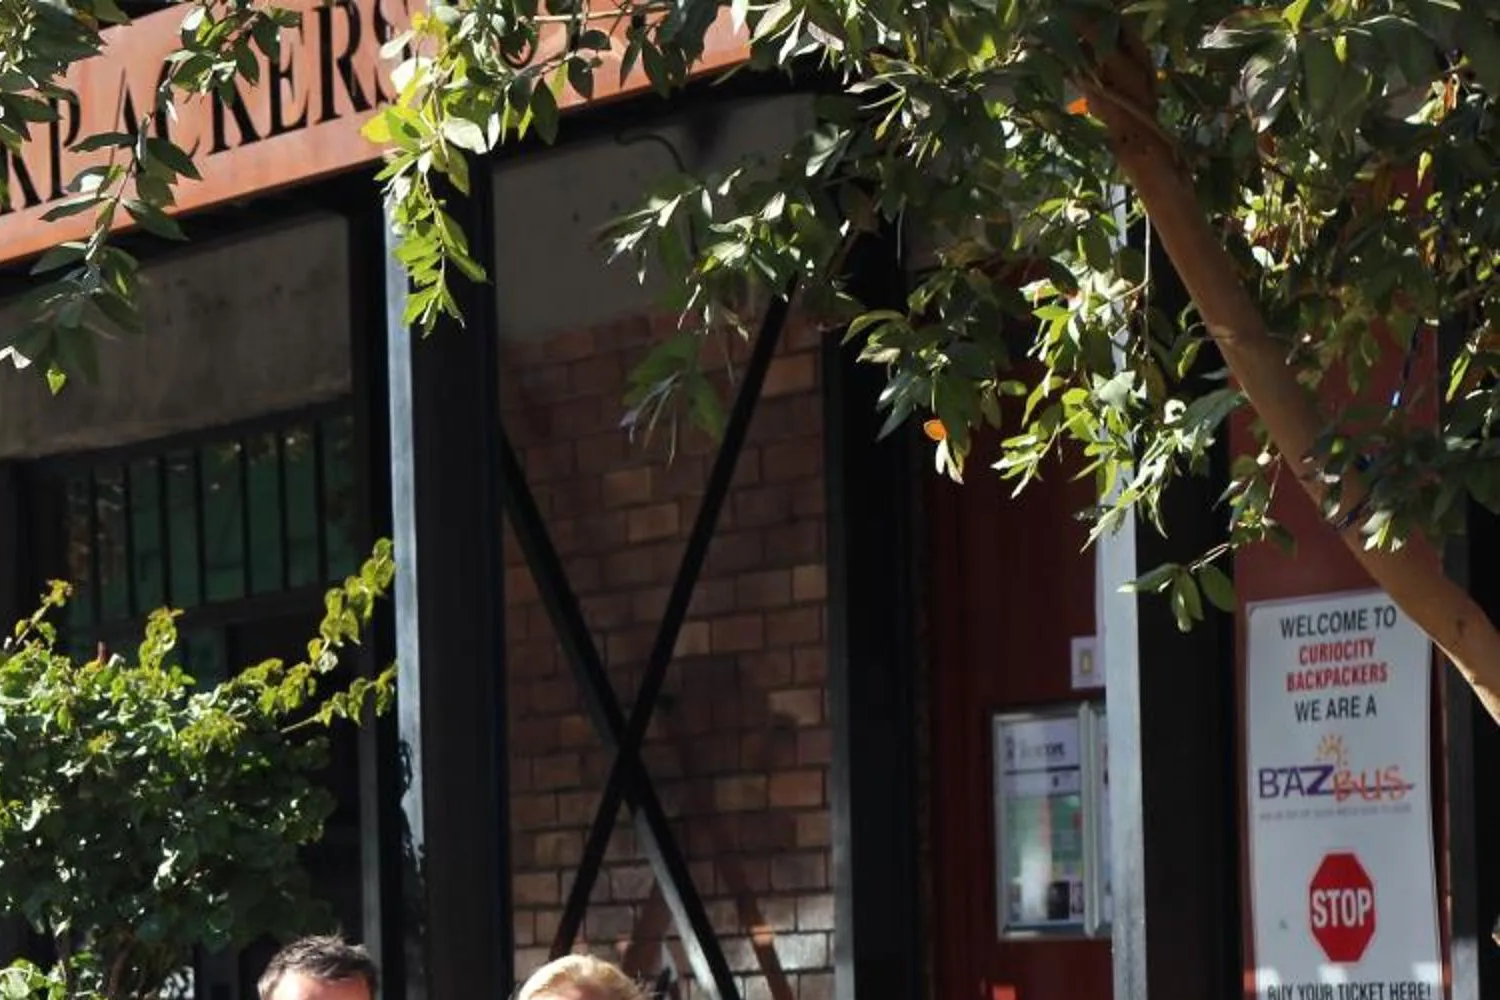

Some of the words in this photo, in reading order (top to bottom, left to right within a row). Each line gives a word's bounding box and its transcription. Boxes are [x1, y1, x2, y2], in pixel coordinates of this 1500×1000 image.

[1280, 607, 1369, 640] WELCOME
[1373, 604, 1397, 630] TO
[1298, 637, 1376, 667] CURIOCITY
[1285, 662, 1389, 693] BACKPACKERS
[1294, 699, 1322, 723] WE
[1325, 695, 1361, 721] ARE
[1365, 693, 1378, 717] A
[1258, 765, 1335, 799] BAZ
[1311, 887, 1373, 929] STOP
